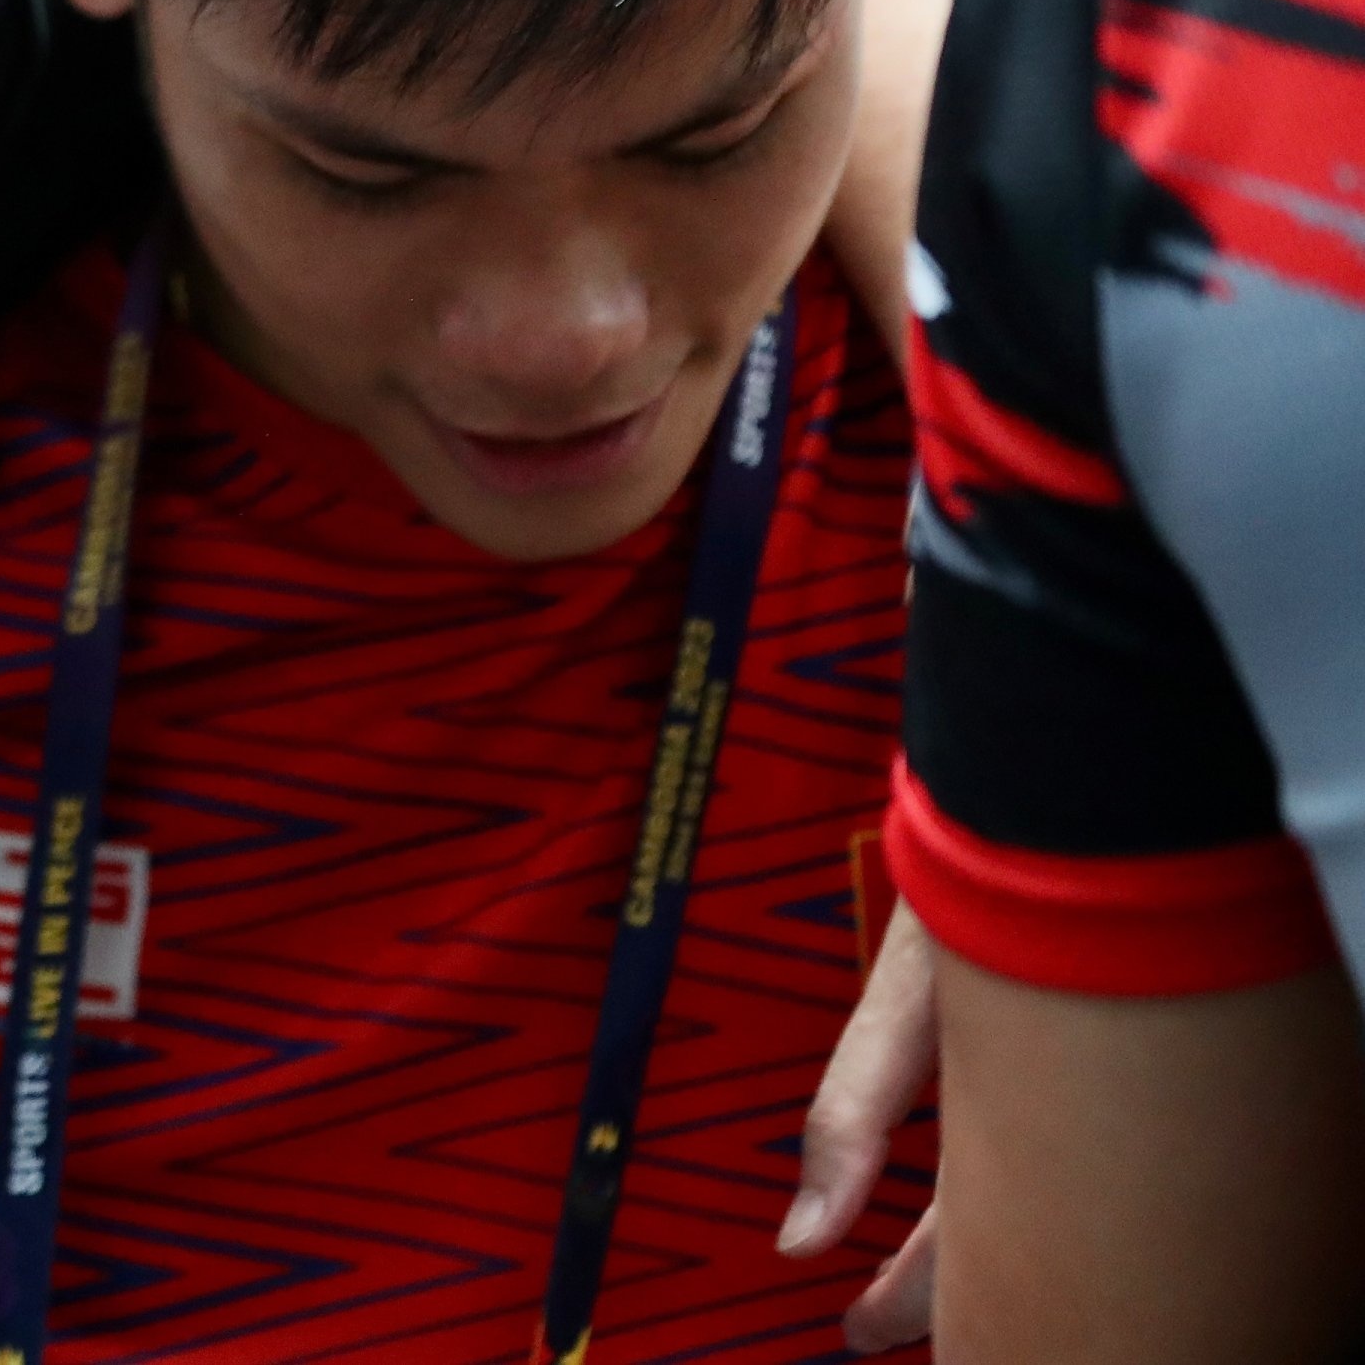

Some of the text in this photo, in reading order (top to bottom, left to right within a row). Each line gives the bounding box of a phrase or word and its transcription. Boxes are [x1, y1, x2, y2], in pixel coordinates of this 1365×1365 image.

[624, 723, 693, 927] CAMBODIA
[7, 795, 85, 1197] SPORTS LIVE IN PEACE
